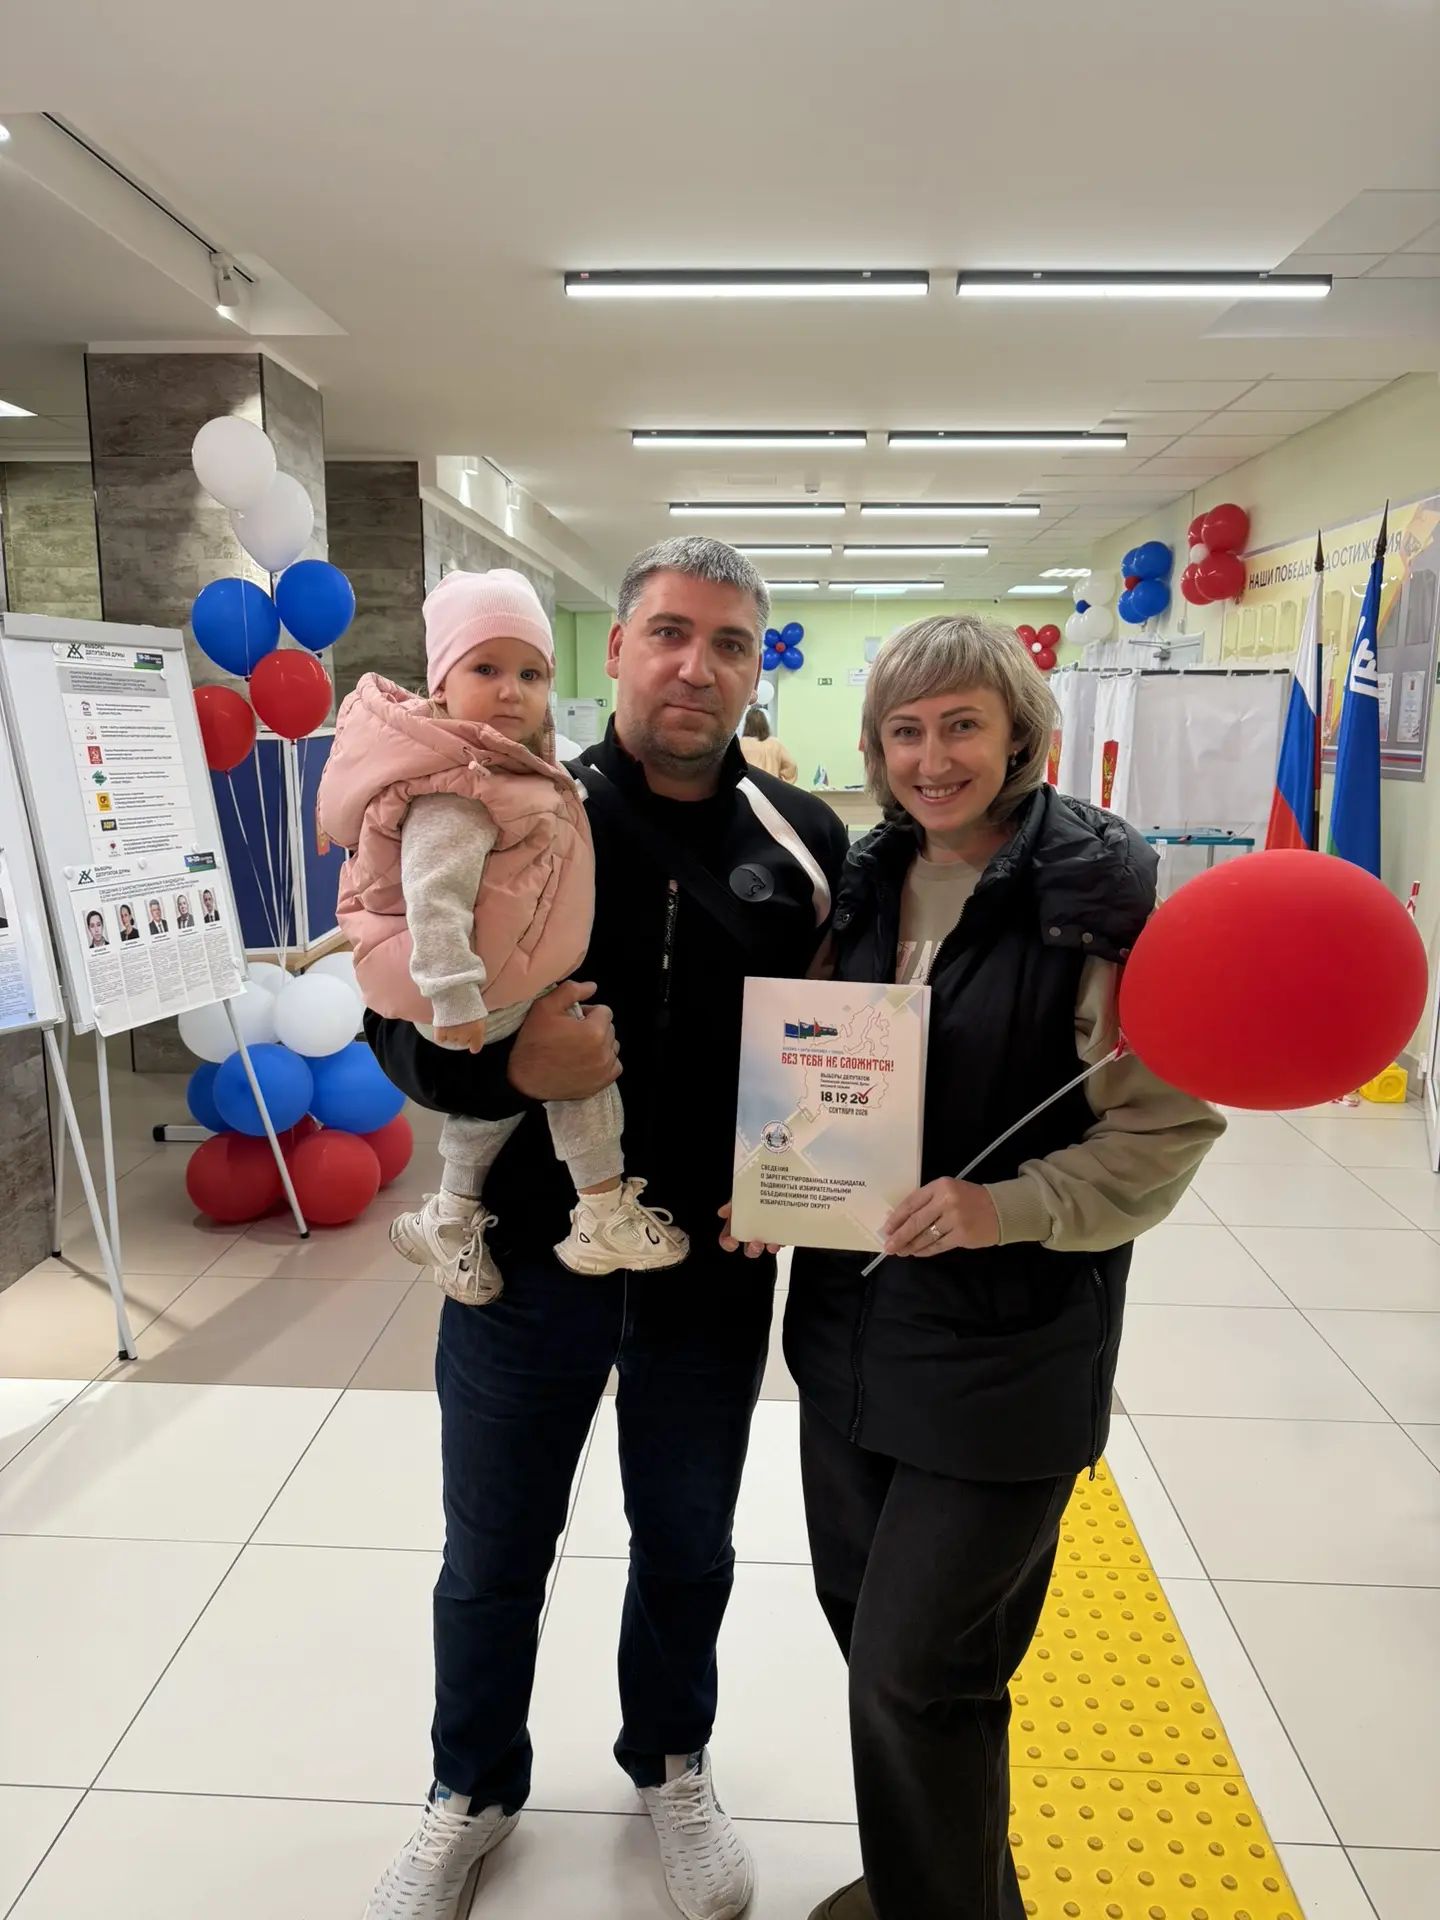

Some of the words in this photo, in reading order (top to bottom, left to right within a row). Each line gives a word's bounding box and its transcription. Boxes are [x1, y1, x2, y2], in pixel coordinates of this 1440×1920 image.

[1249, 571, 1273, 590] НАШИ
[1275, 558, 1313, 582] ПОБЕДЫ
[1324, 532, 1401, 571] ДОСТИЖЕИЯ
[782, 1052, 798, 1065] БЕЗ
[800, 1054, 823, 1067] ТЕБЯ
[826, 1056, 838, 1068] НЕ
[840, 1057, 895, 1072] СЛОЖИТСЯ!
[761, 1164, 789, 1172] СВЕДЕНИЯ
[766, 1174, 828, 1184] ЗАРЕГИСТРИРОВАННЫХ
[761, 1182, 798, 1190] ВЫДВИНУТЫХ
[799, 1185, 852, 1194] ИЗБИРАТЕЛЬНЫМИ
[761, 1190, 809, 1200] ОБЪЕДИНЕНИЯМИ
[761, 1199, 809, 1208] ИЗБИРАТЕЛЬНОМУ
